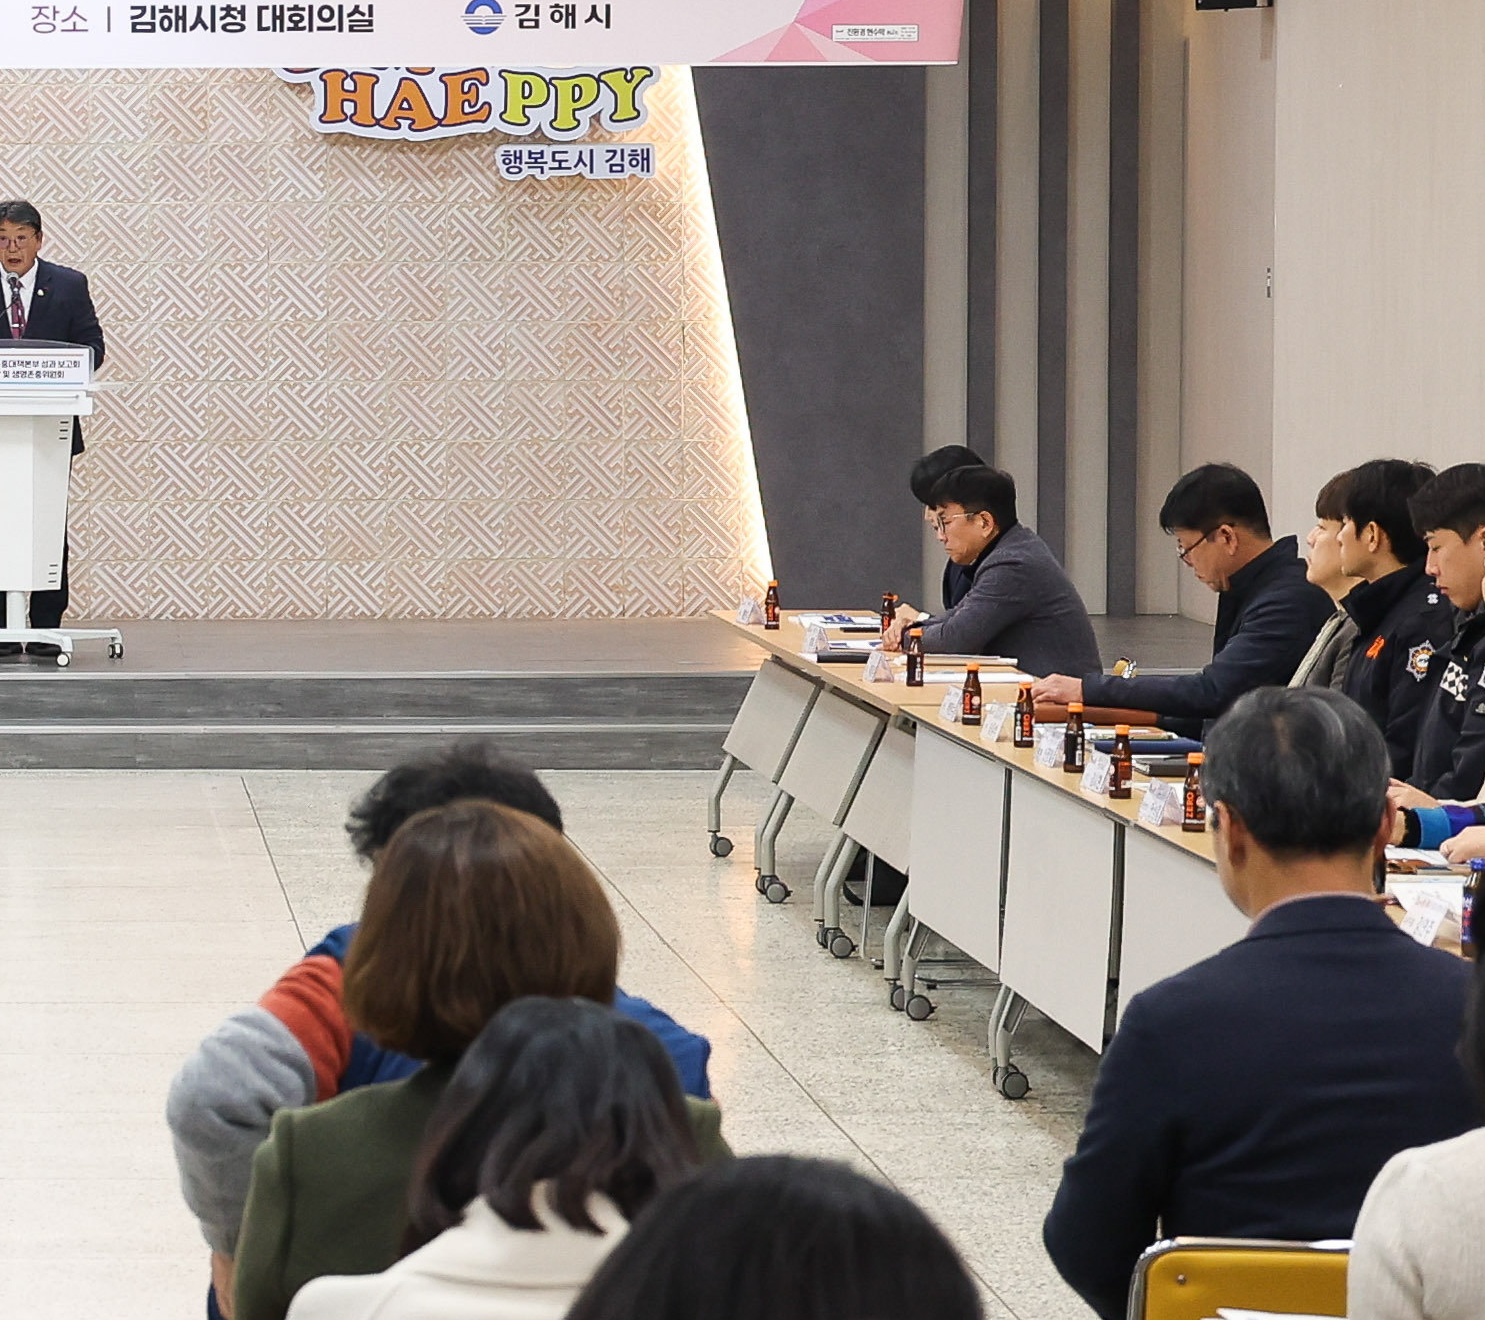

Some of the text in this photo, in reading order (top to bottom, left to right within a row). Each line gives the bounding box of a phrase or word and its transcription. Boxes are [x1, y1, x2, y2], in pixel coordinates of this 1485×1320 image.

[31, 5, 89, 34] 장소
[129, 4, 247, 34] 김해시청
[257, 4, 374, 34] 대회의실
[500, 148, 652, 175] 행복도시 김해
[58, 360, 81, 368] 보고회
[1186, 791, 1194, 818] ZERO
